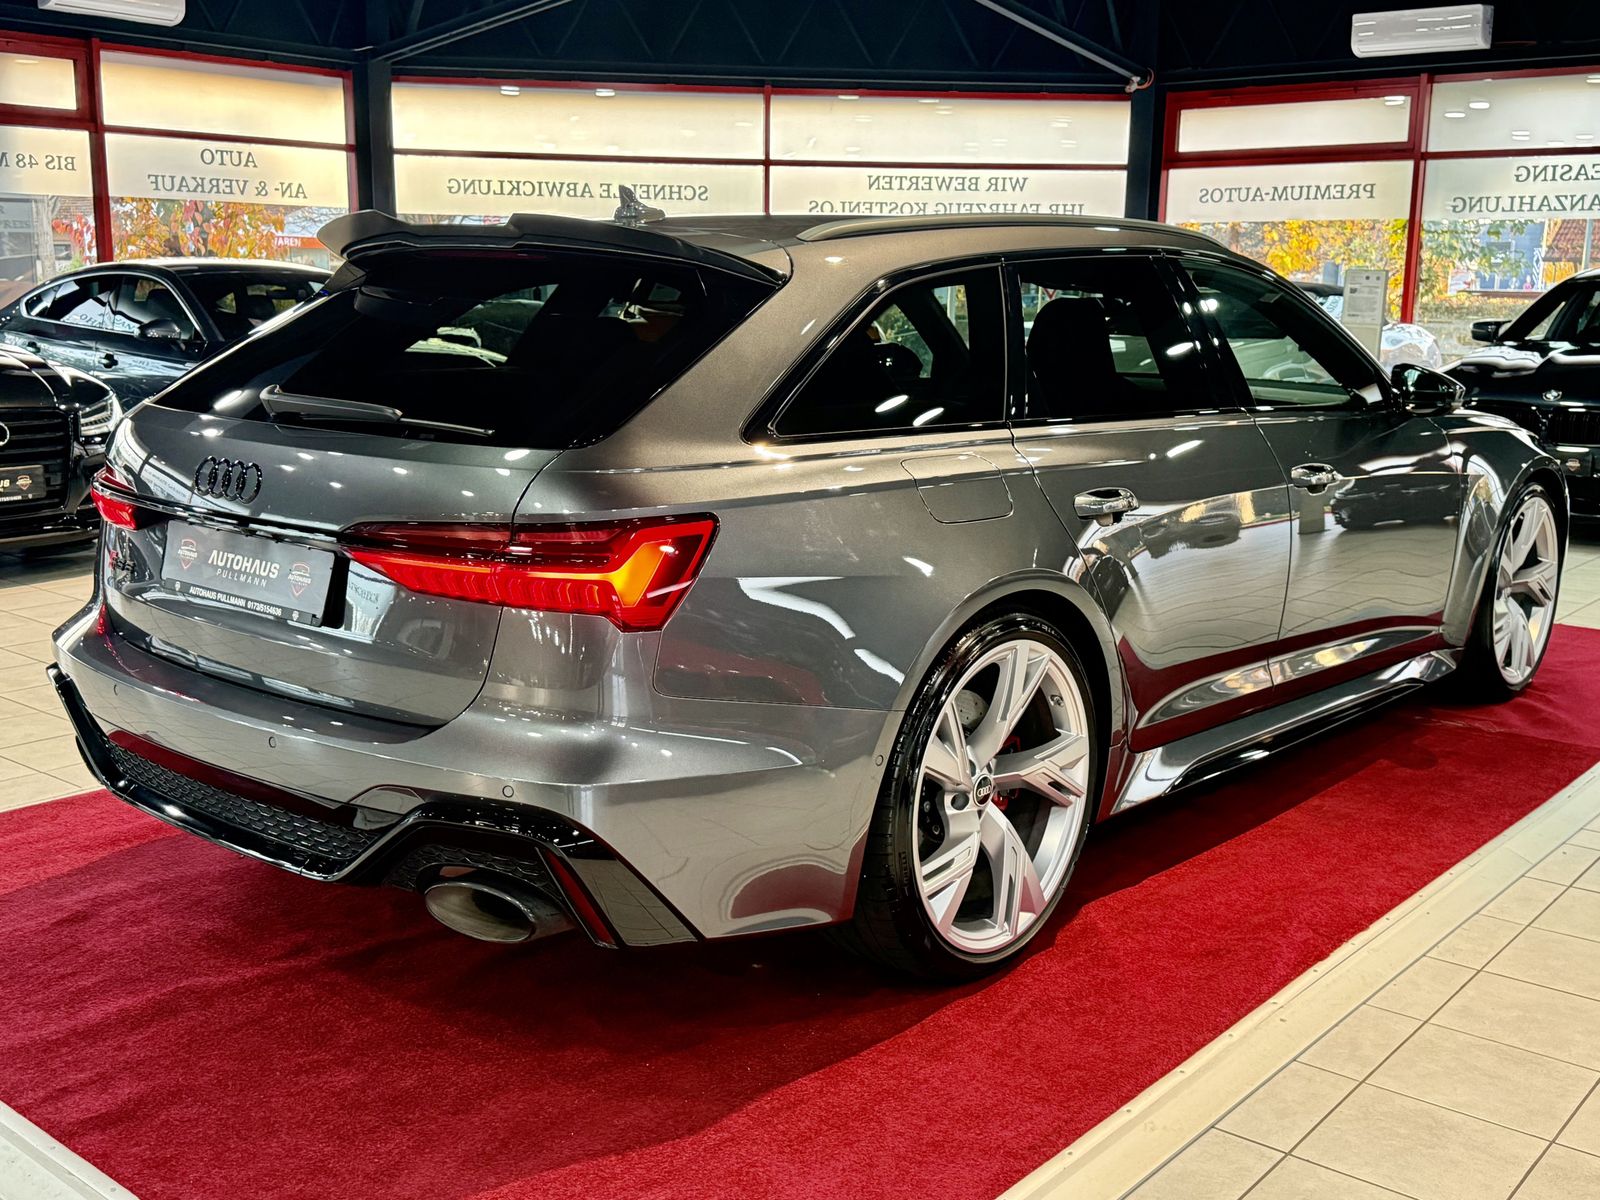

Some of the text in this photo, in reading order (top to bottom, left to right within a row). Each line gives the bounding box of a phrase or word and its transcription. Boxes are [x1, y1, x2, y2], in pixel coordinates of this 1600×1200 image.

[208, 549, 280, 578] AUTOHAUS
[216, 568, 268, 588] PULLMANN
[189, 586, 217, 600] AUTOHAUS
[217, 593, 247, 607] PULLMANN
